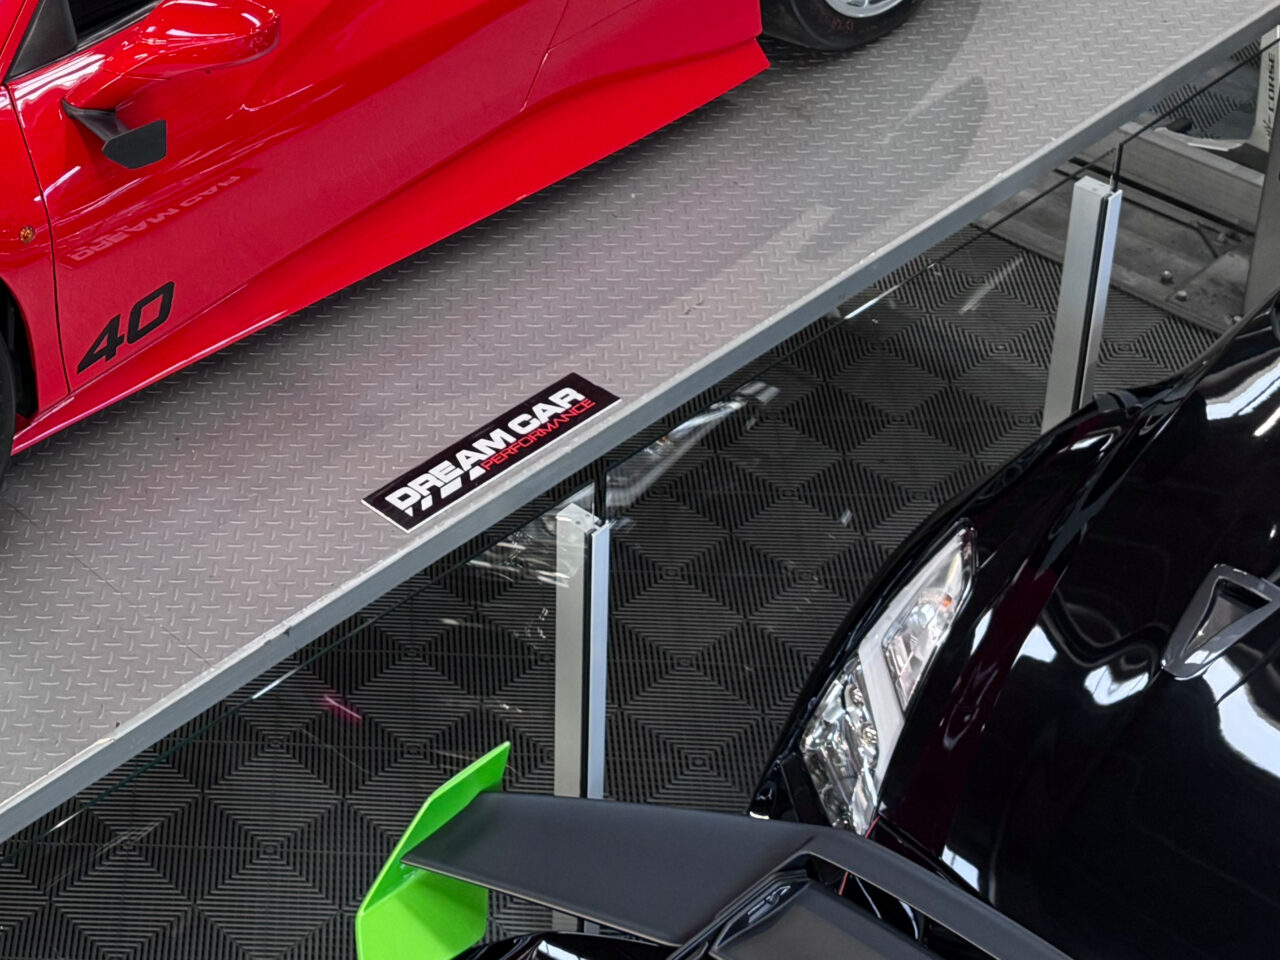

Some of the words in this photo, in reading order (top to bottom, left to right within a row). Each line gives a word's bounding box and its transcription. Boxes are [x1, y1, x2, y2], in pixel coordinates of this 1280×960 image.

[77, 281, 175, 374] 40
[385, 427, 517, 514] DREAM
[507, 387, 586, 435] CAR
[481, 398, 596, 471] PERFORMANCE
